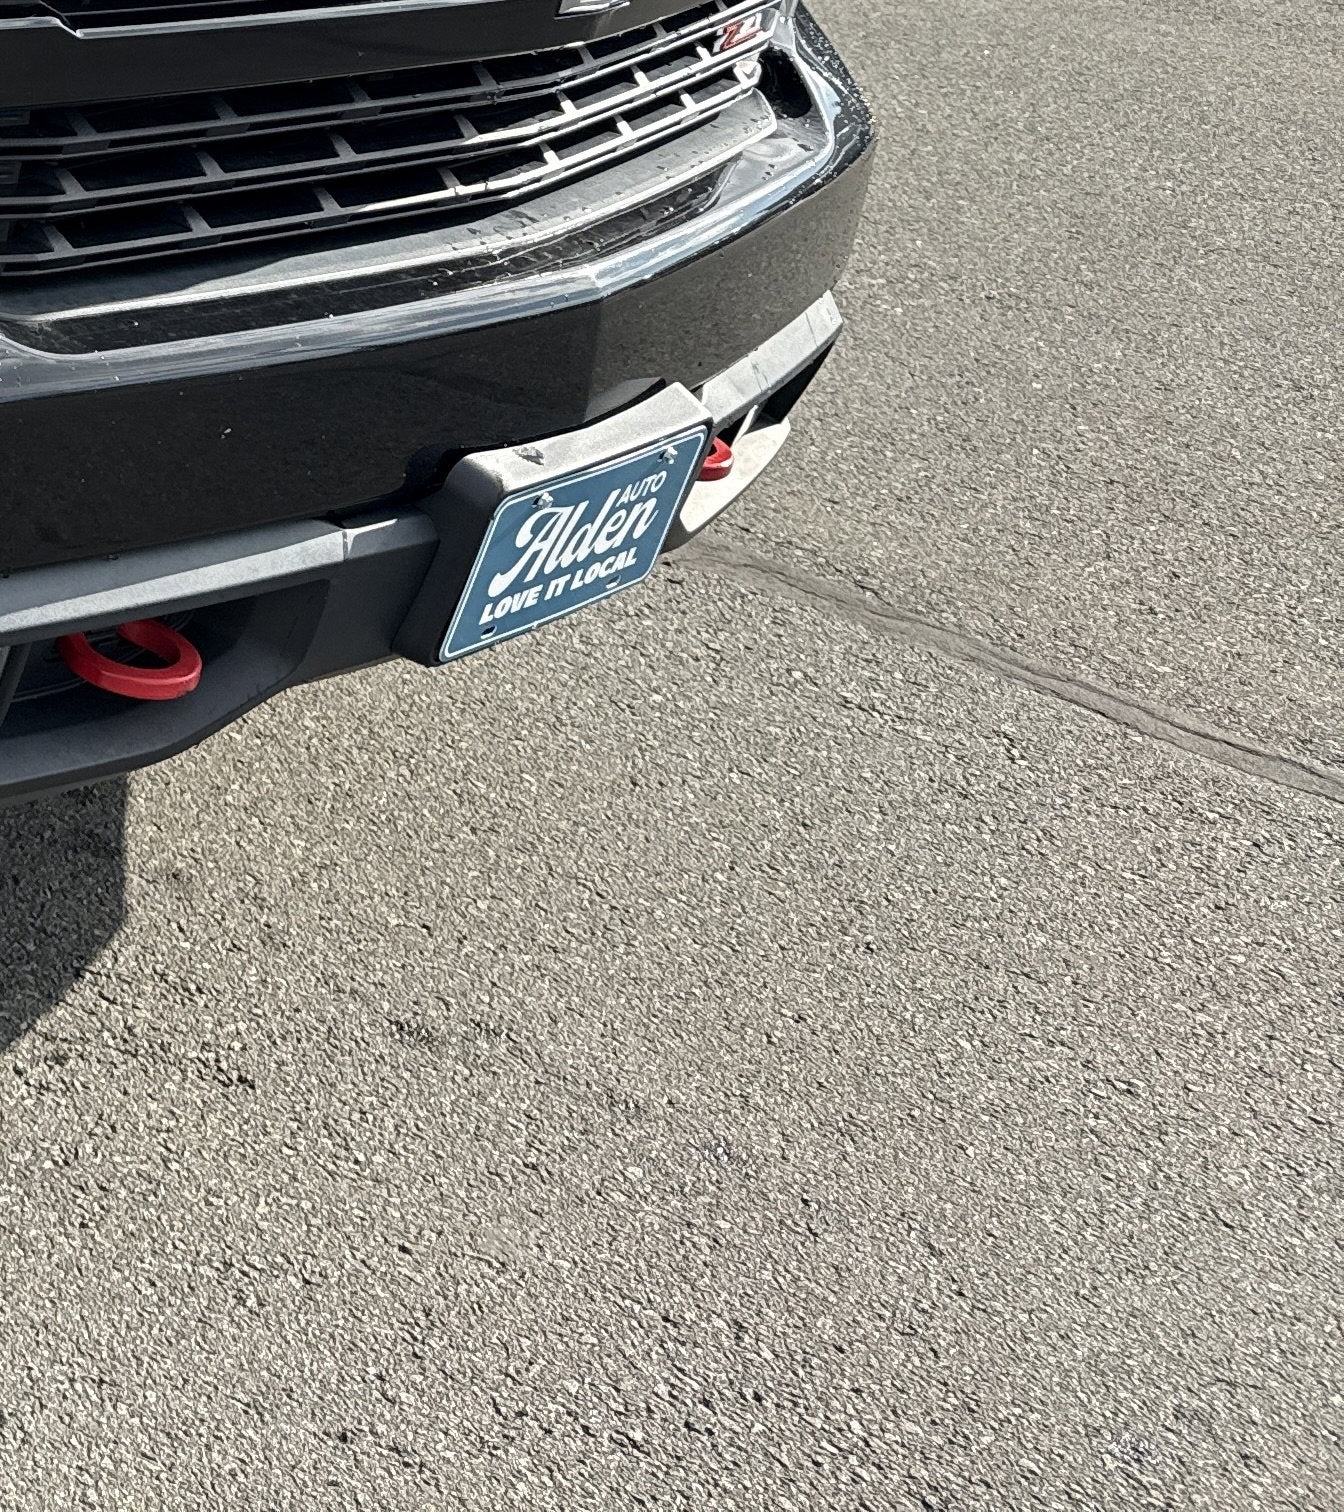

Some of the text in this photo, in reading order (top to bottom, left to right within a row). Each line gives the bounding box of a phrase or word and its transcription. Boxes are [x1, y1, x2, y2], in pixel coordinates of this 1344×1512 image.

[616, 469, 668, 509] AUTO
[487, 489, 661, 599] Alden
[478, 546, 638, 626] LOVE IT LOCAL
